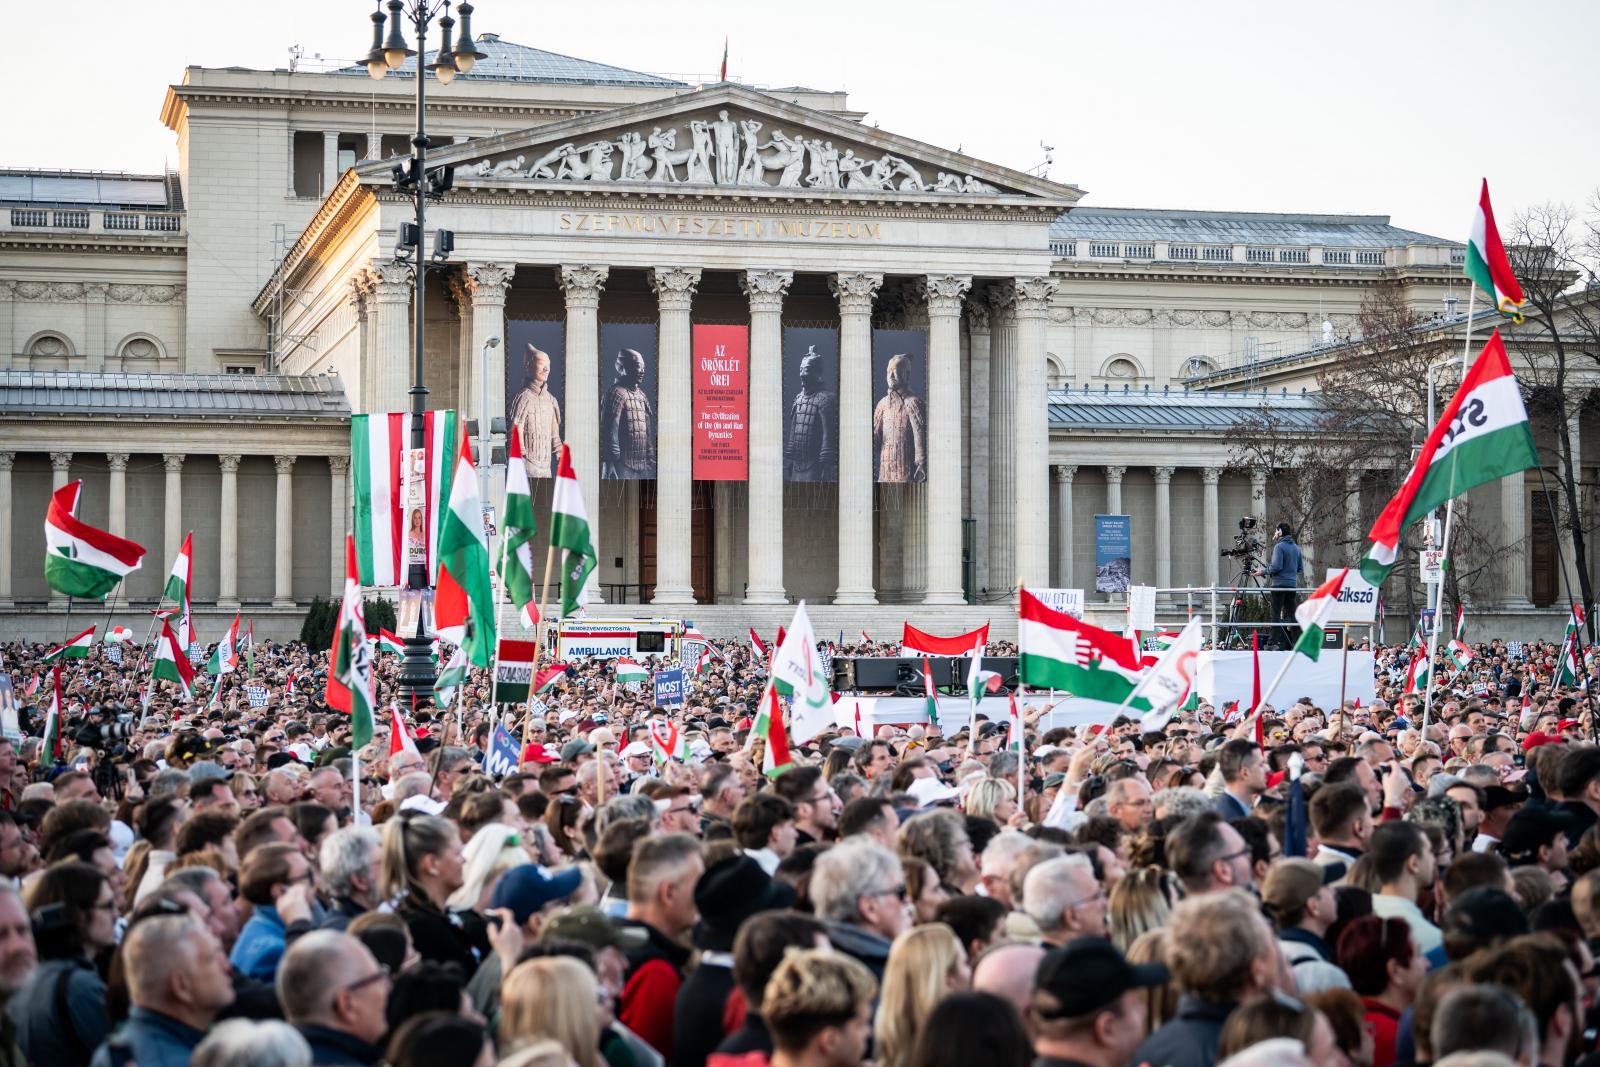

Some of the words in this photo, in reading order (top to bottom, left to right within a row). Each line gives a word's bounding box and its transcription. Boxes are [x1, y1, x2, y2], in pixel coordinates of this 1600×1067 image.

[714, 344, 725, 357] AZ
[701, 356, 740, 372] ÖRÖKLÉT
[698, 421, 703, 429] of
[704, 421, 713, 430] the
[723, 421, 733, 430] and
[1336, 587, 1373, 603] zikszó
[657, 680, 681, 694] MOST
